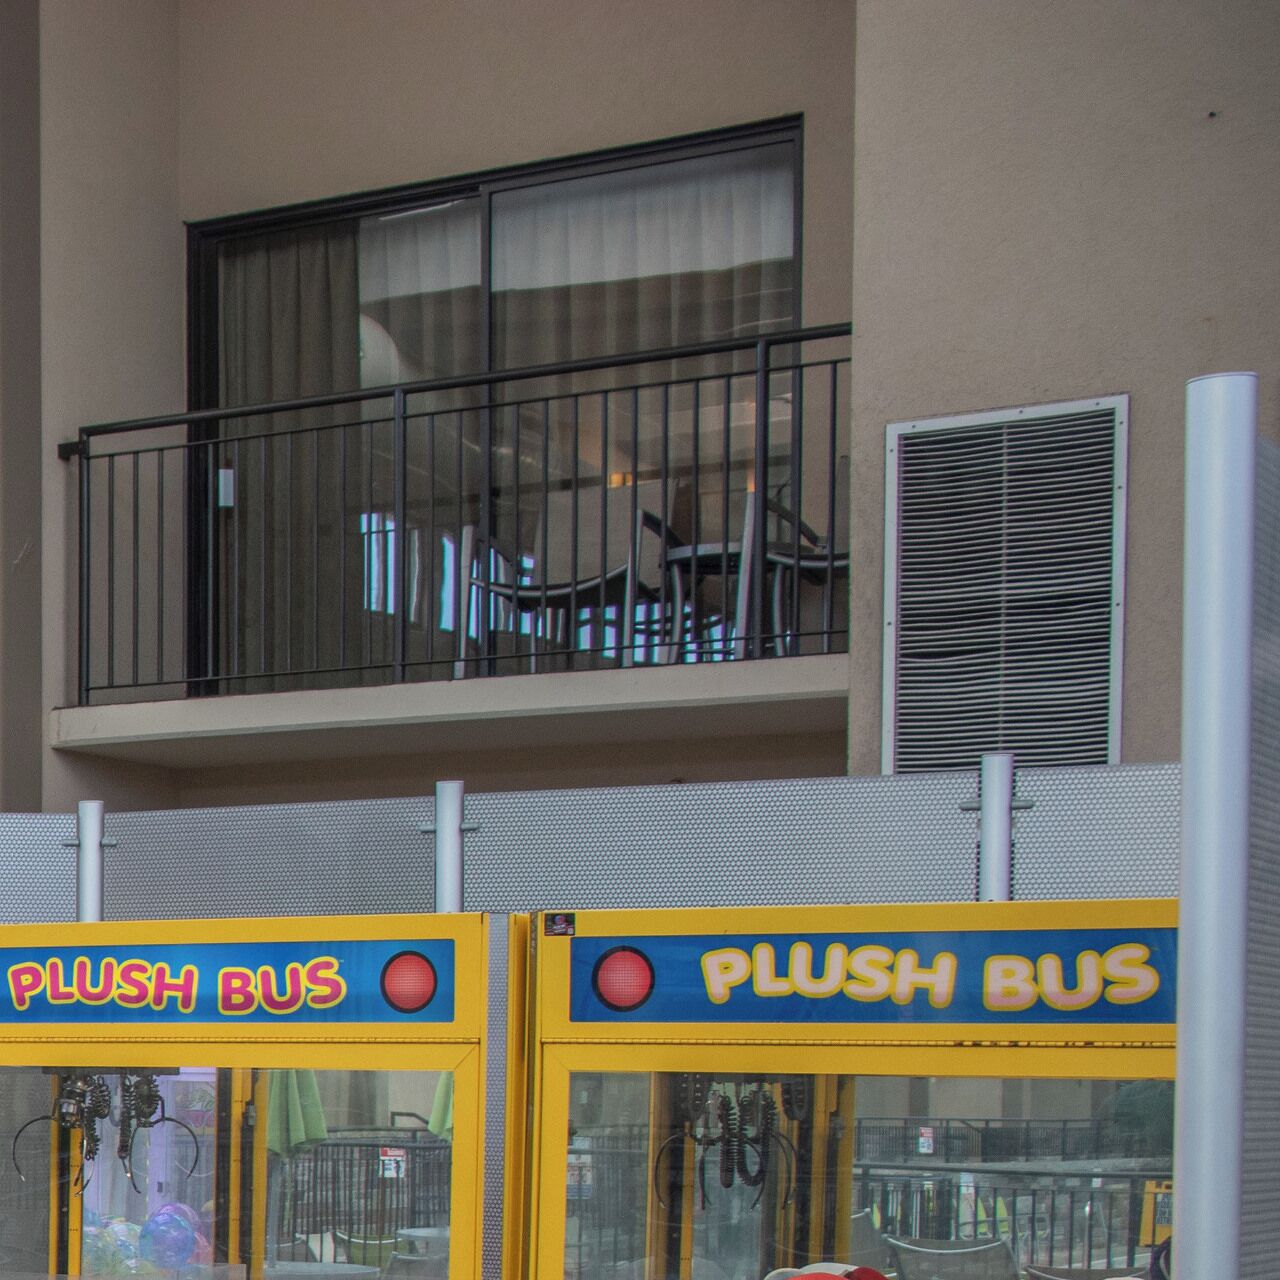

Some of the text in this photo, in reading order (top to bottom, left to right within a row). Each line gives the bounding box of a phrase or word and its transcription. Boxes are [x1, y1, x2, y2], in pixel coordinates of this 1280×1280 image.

[8, 955, 347, 1016] PLUSH BUS
[699, 940, 1160, 1013] PLUSH BUS
